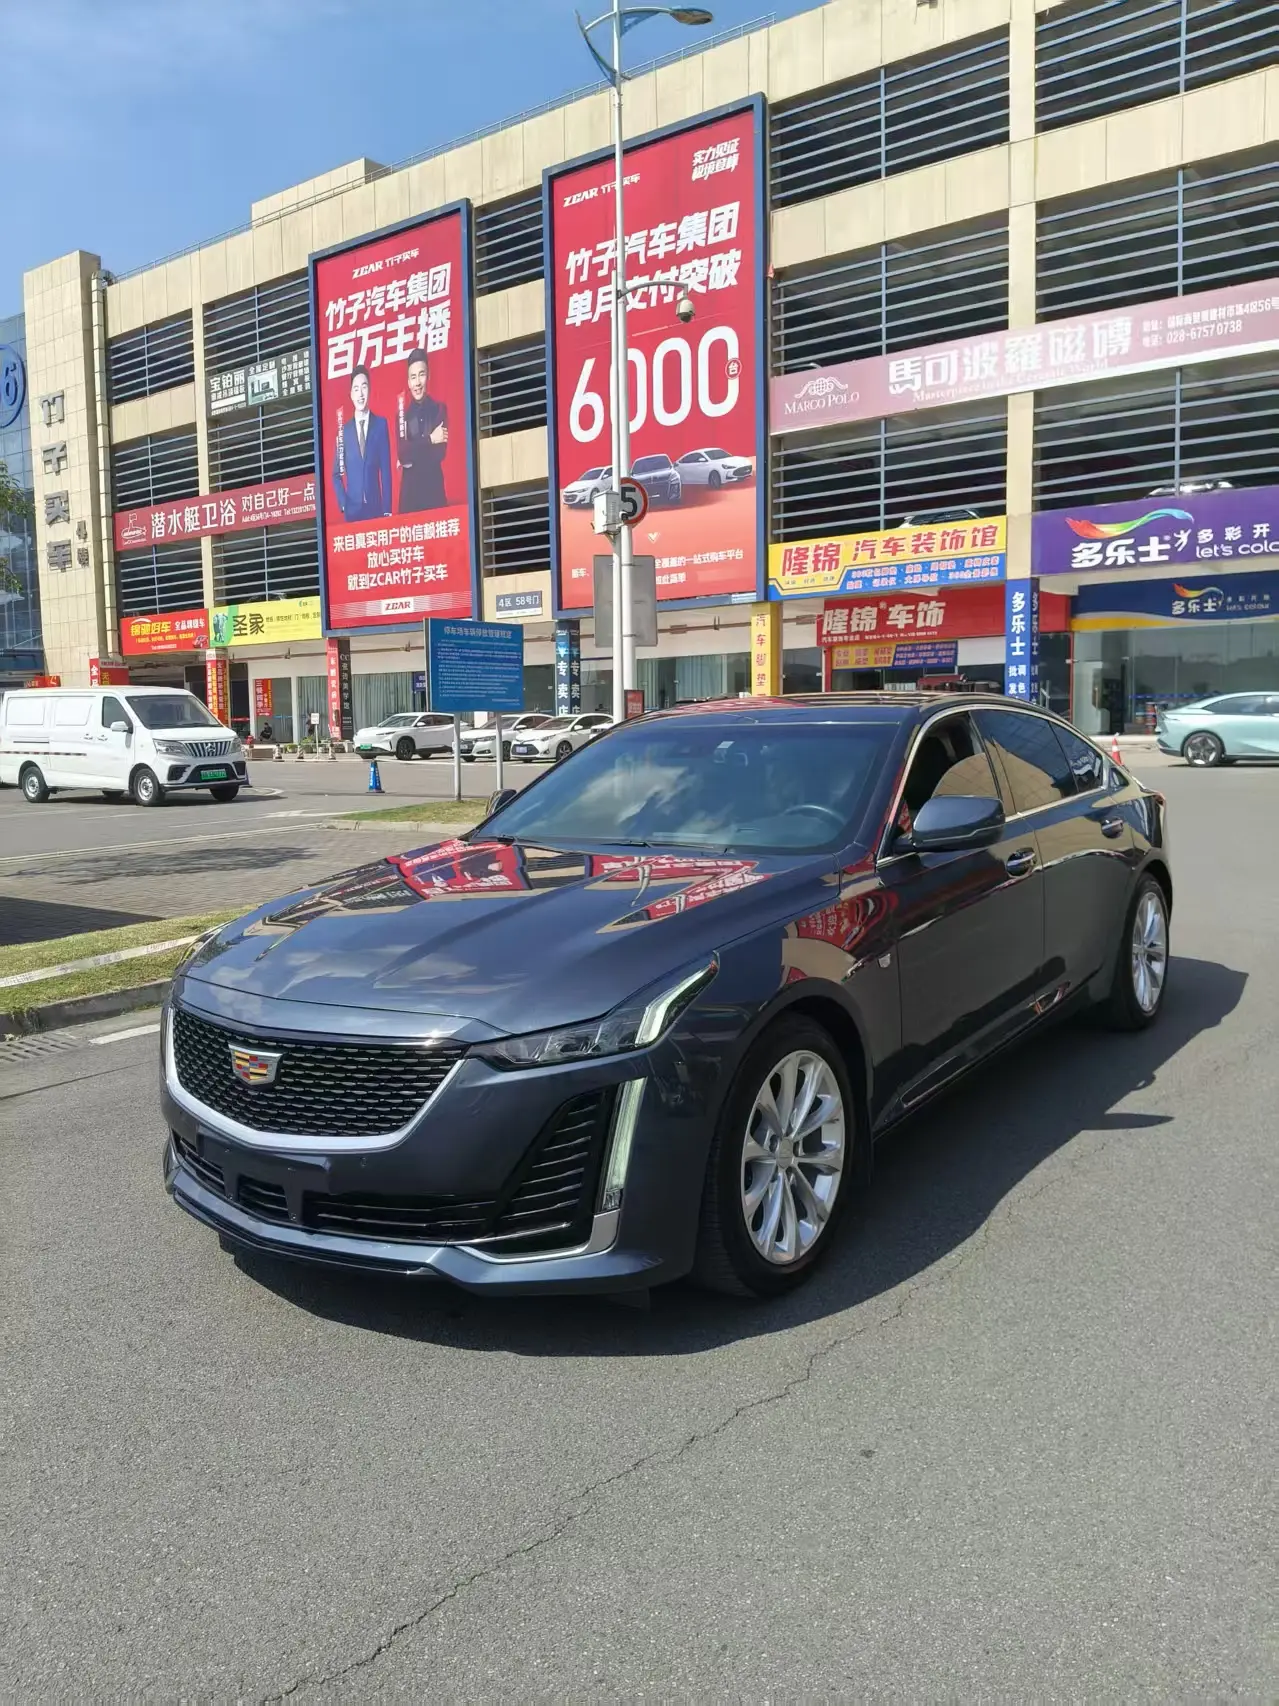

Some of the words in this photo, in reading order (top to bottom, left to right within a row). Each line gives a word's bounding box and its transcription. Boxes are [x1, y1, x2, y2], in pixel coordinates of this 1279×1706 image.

[563, 187, 599, 207] ZCAR
[565, 201, 740, 285] 竹子汽车集团
[352, 261, 384, 279] ZCAR
[325, 262, 451, 331] 竹子汽车集团
[328, 300, 451, 379] 百万主播
[569, 326, 739, 443] 6000
[784, 399, 825, 415] MARCO
[828, 391, 860, 407] POLO
[241, 482, 316, 512] 对自己好一点
[621, 486, 637, 521] 5
[151, 498, 236, 538] 潜水艇卫浴
[333, 518, 460, 552] 来自真实用户的信赖推荐
[782, 543, 841, 576] 隆锦
[852, 525, 998, 561] 汽车装饰馆
[1196, 543, 1233, 558] let's
[367, 545, 424, 569] 放心买好车
[1071, 536, 1171, 568] 多乐士
[347, 564, 448, 591] 就到ZCAR竹子买车
[385, 600, 411, 612] ZCAR
[498, 598, 512, 608] 4区
[515, 595, 539, 606] 58号门
[1172, 598, 1217, 615] 多乐士
[233, 613, 265, 637] 圣象
[822, 606, 878, 635] 隆锦
[886, 601, 946, 629] 车饰
[1010, 592, 1026, 656] 多乐士
